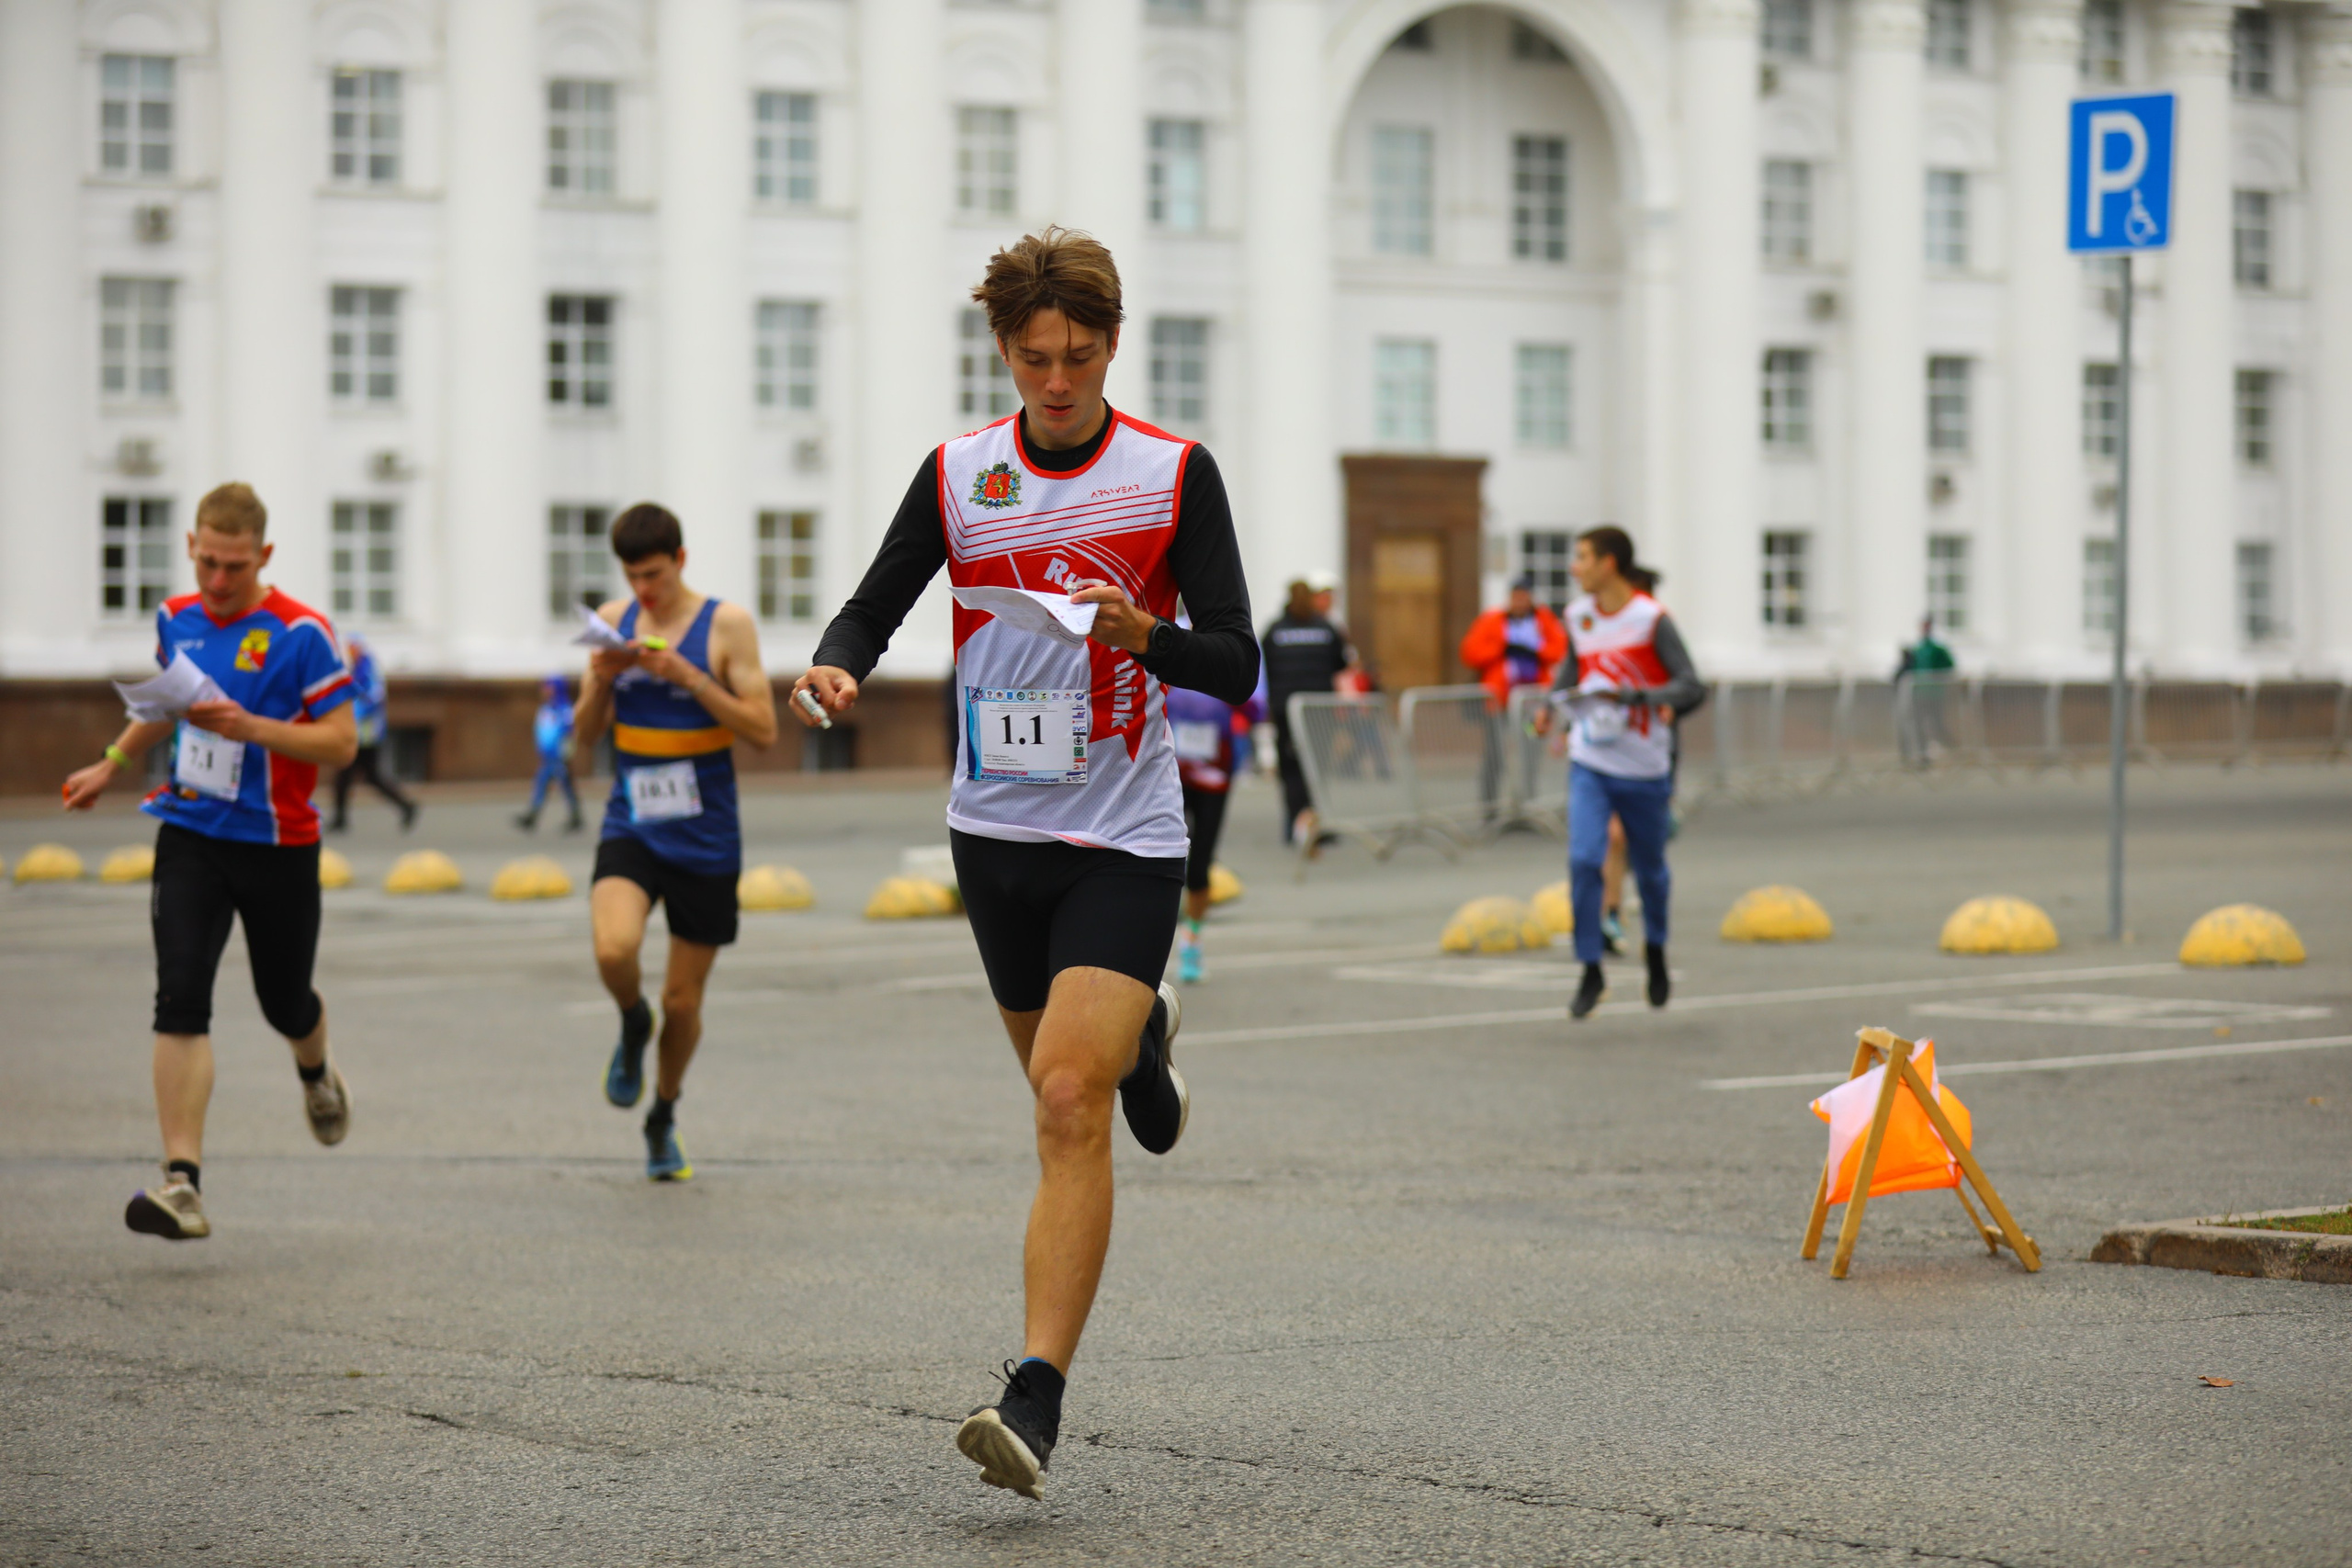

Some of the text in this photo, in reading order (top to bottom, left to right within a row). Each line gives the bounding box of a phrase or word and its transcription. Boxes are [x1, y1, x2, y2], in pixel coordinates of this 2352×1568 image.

[2086, 109, 2149, 238] P
[1111, 659, 1138, 729] think
[1000, 715, 1046, 745] 1.1
